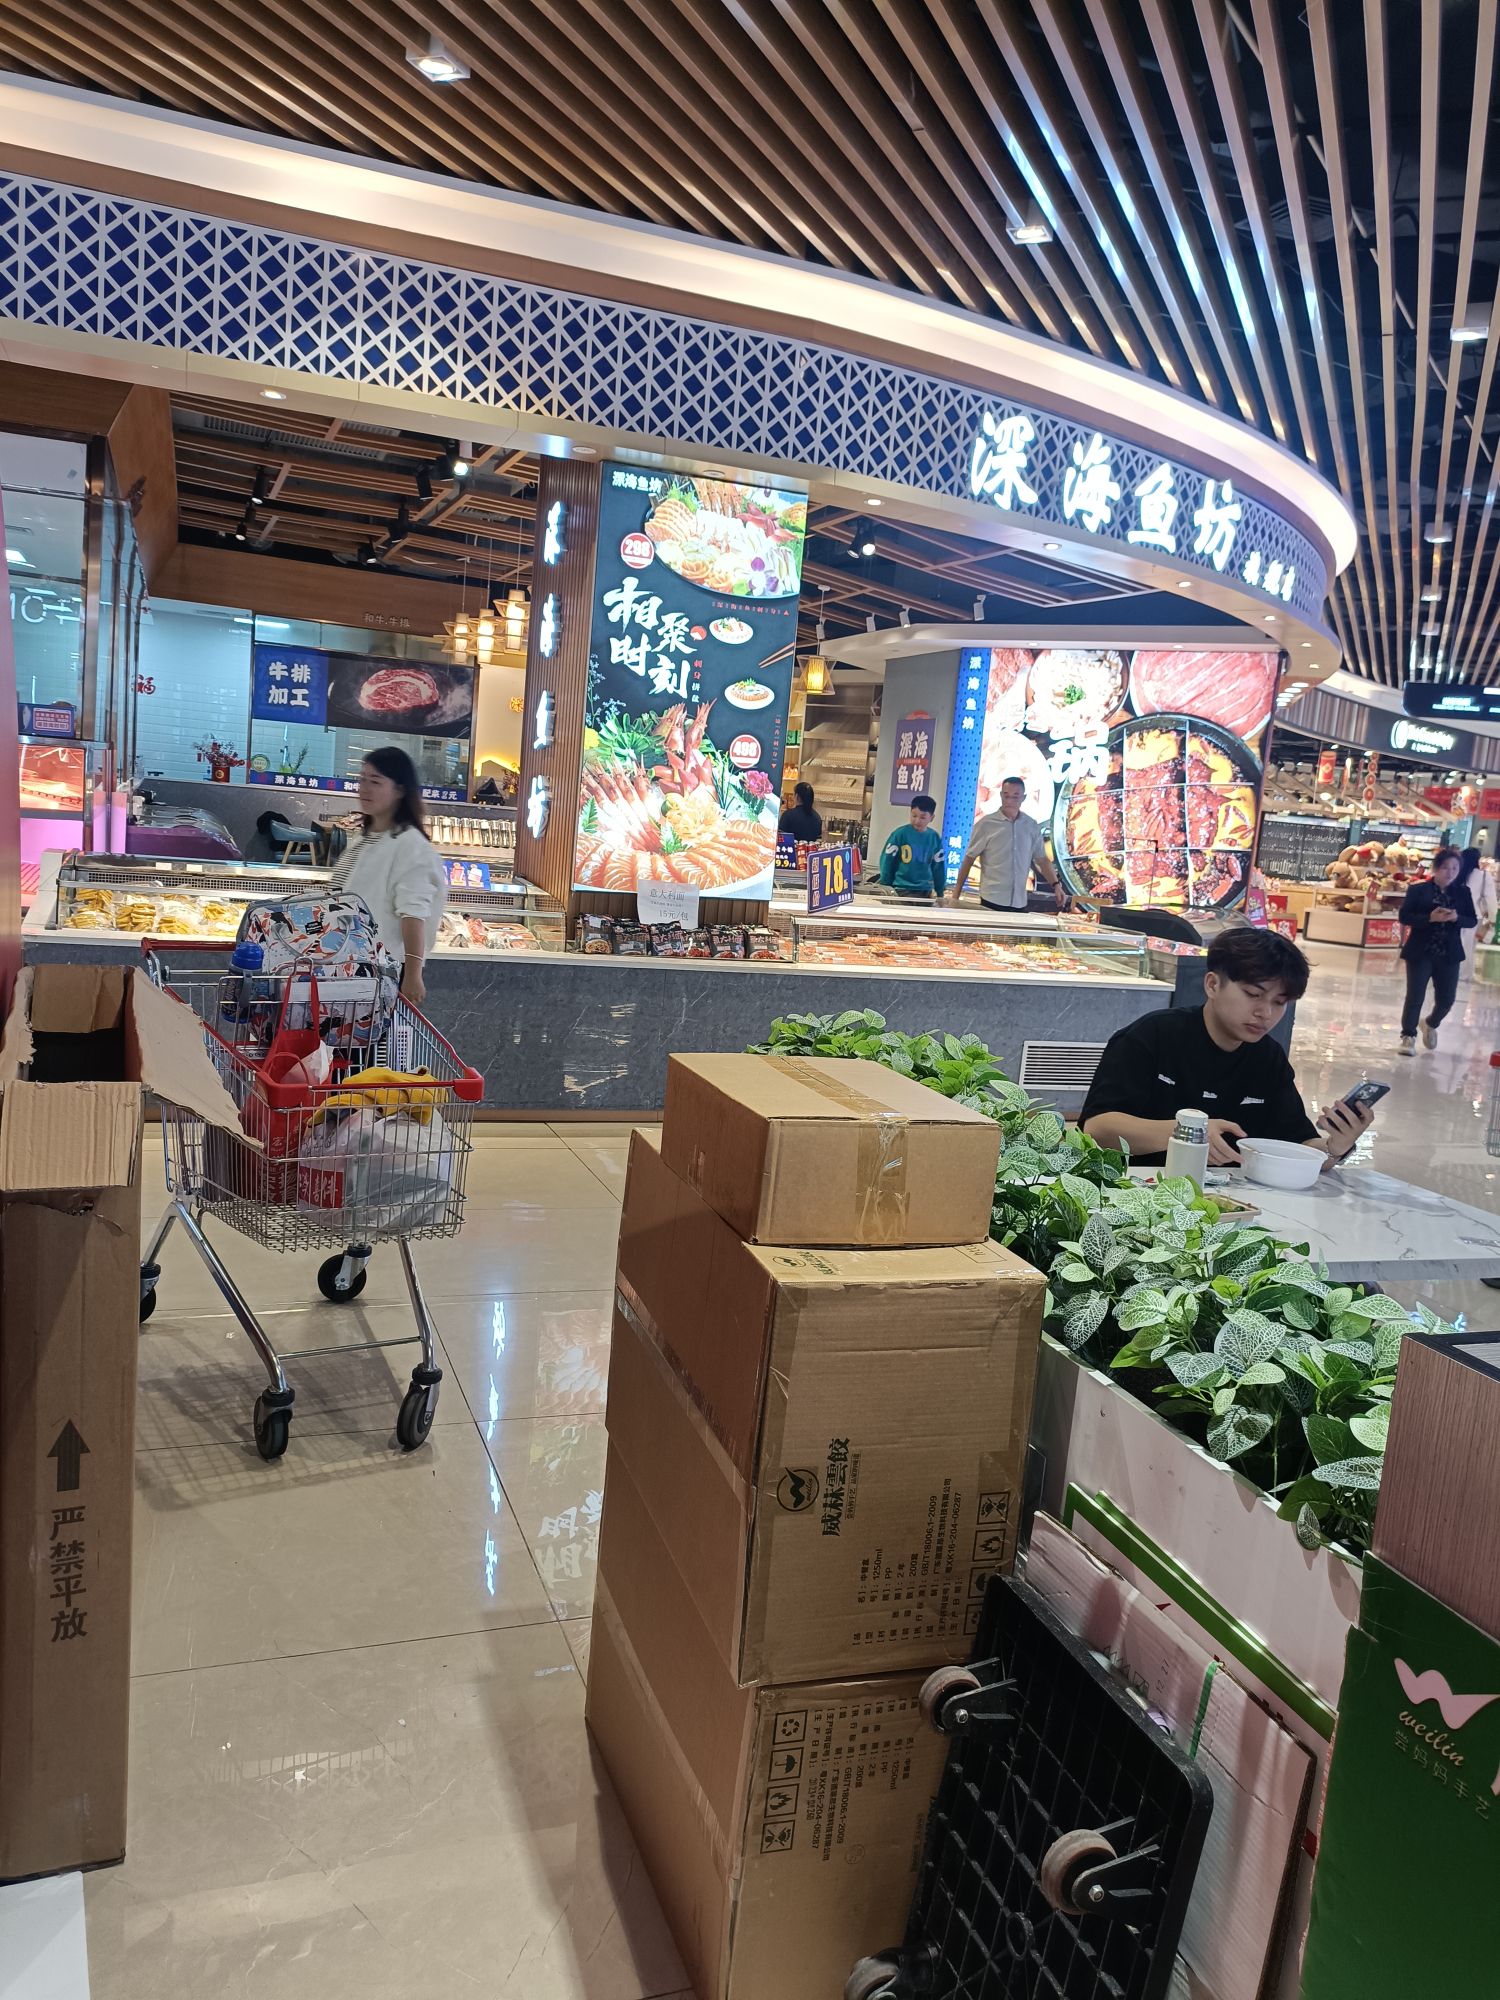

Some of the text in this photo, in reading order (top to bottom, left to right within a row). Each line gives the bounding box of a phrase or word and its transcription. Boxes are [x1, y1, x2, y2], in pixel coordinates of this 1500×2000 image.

[970, 411, 1242, 573] 深海鱼坊
[268, 662, 311, 684] 牛排
[267, 685, 310, 708] 加工
[961, 656, 983, 730] 深海鱼坊
[900, 730, 930, 760] 深海
[274, 774, 318, 788] 深海鱼坊
[895, 764, 926, 792] 鱼坊
[650, 888, 686, 901] 意大利面
[660, 909, 689, 921] 15元/包
[50, 1505, 88, 1643] 严禁平放
[873, 1549, 883, 1580] 1250ml
[1399, 1710, 1465, 1767] weilin
